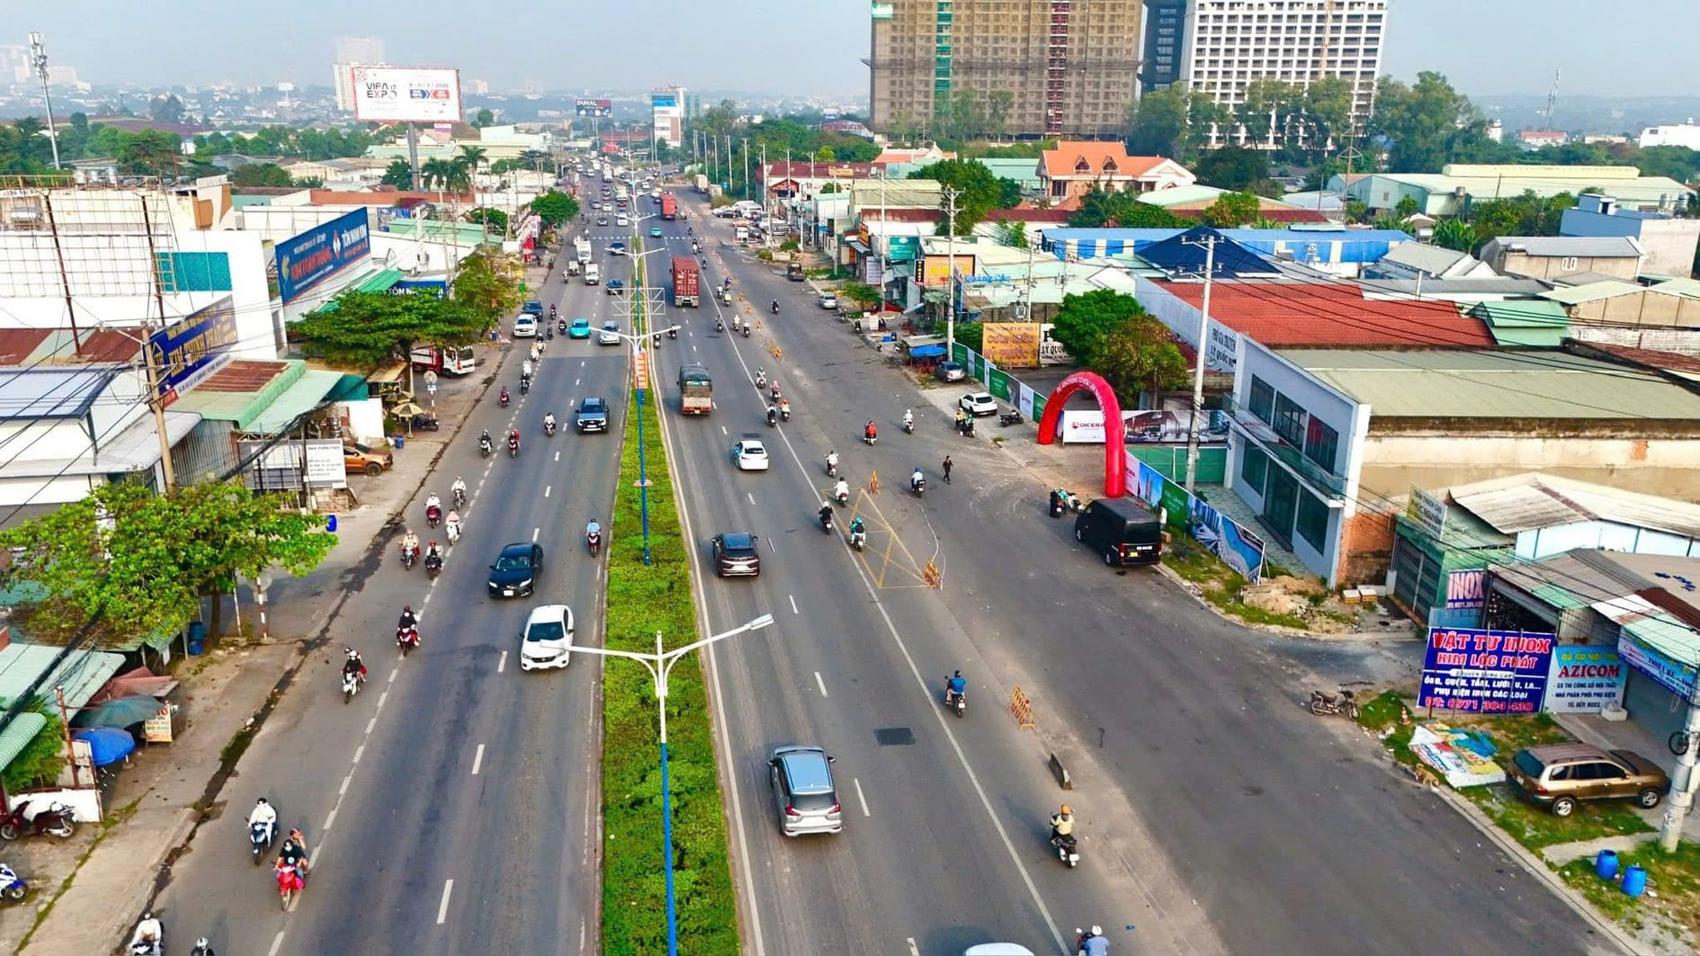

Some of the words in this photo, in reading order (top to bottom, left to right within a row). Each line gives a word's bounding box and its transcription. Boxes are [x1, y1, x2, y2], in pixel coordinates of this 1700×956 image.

[366, 82, 389, 90] VIFA
[1448, 572, 1484, 600] INOX
[1432, 630, 1470, 652] VẬT
[1474, 634, 1503, 652] TƯ
[1502, 636, 1552, 654] INOX
[1436, 652, 1468, 665] KIM
[1470, 654, 1498, 668] LỘC
[1500, 654, 1538, 668] PHÁT
[1558, 664, 1621, 678] AZICOM
